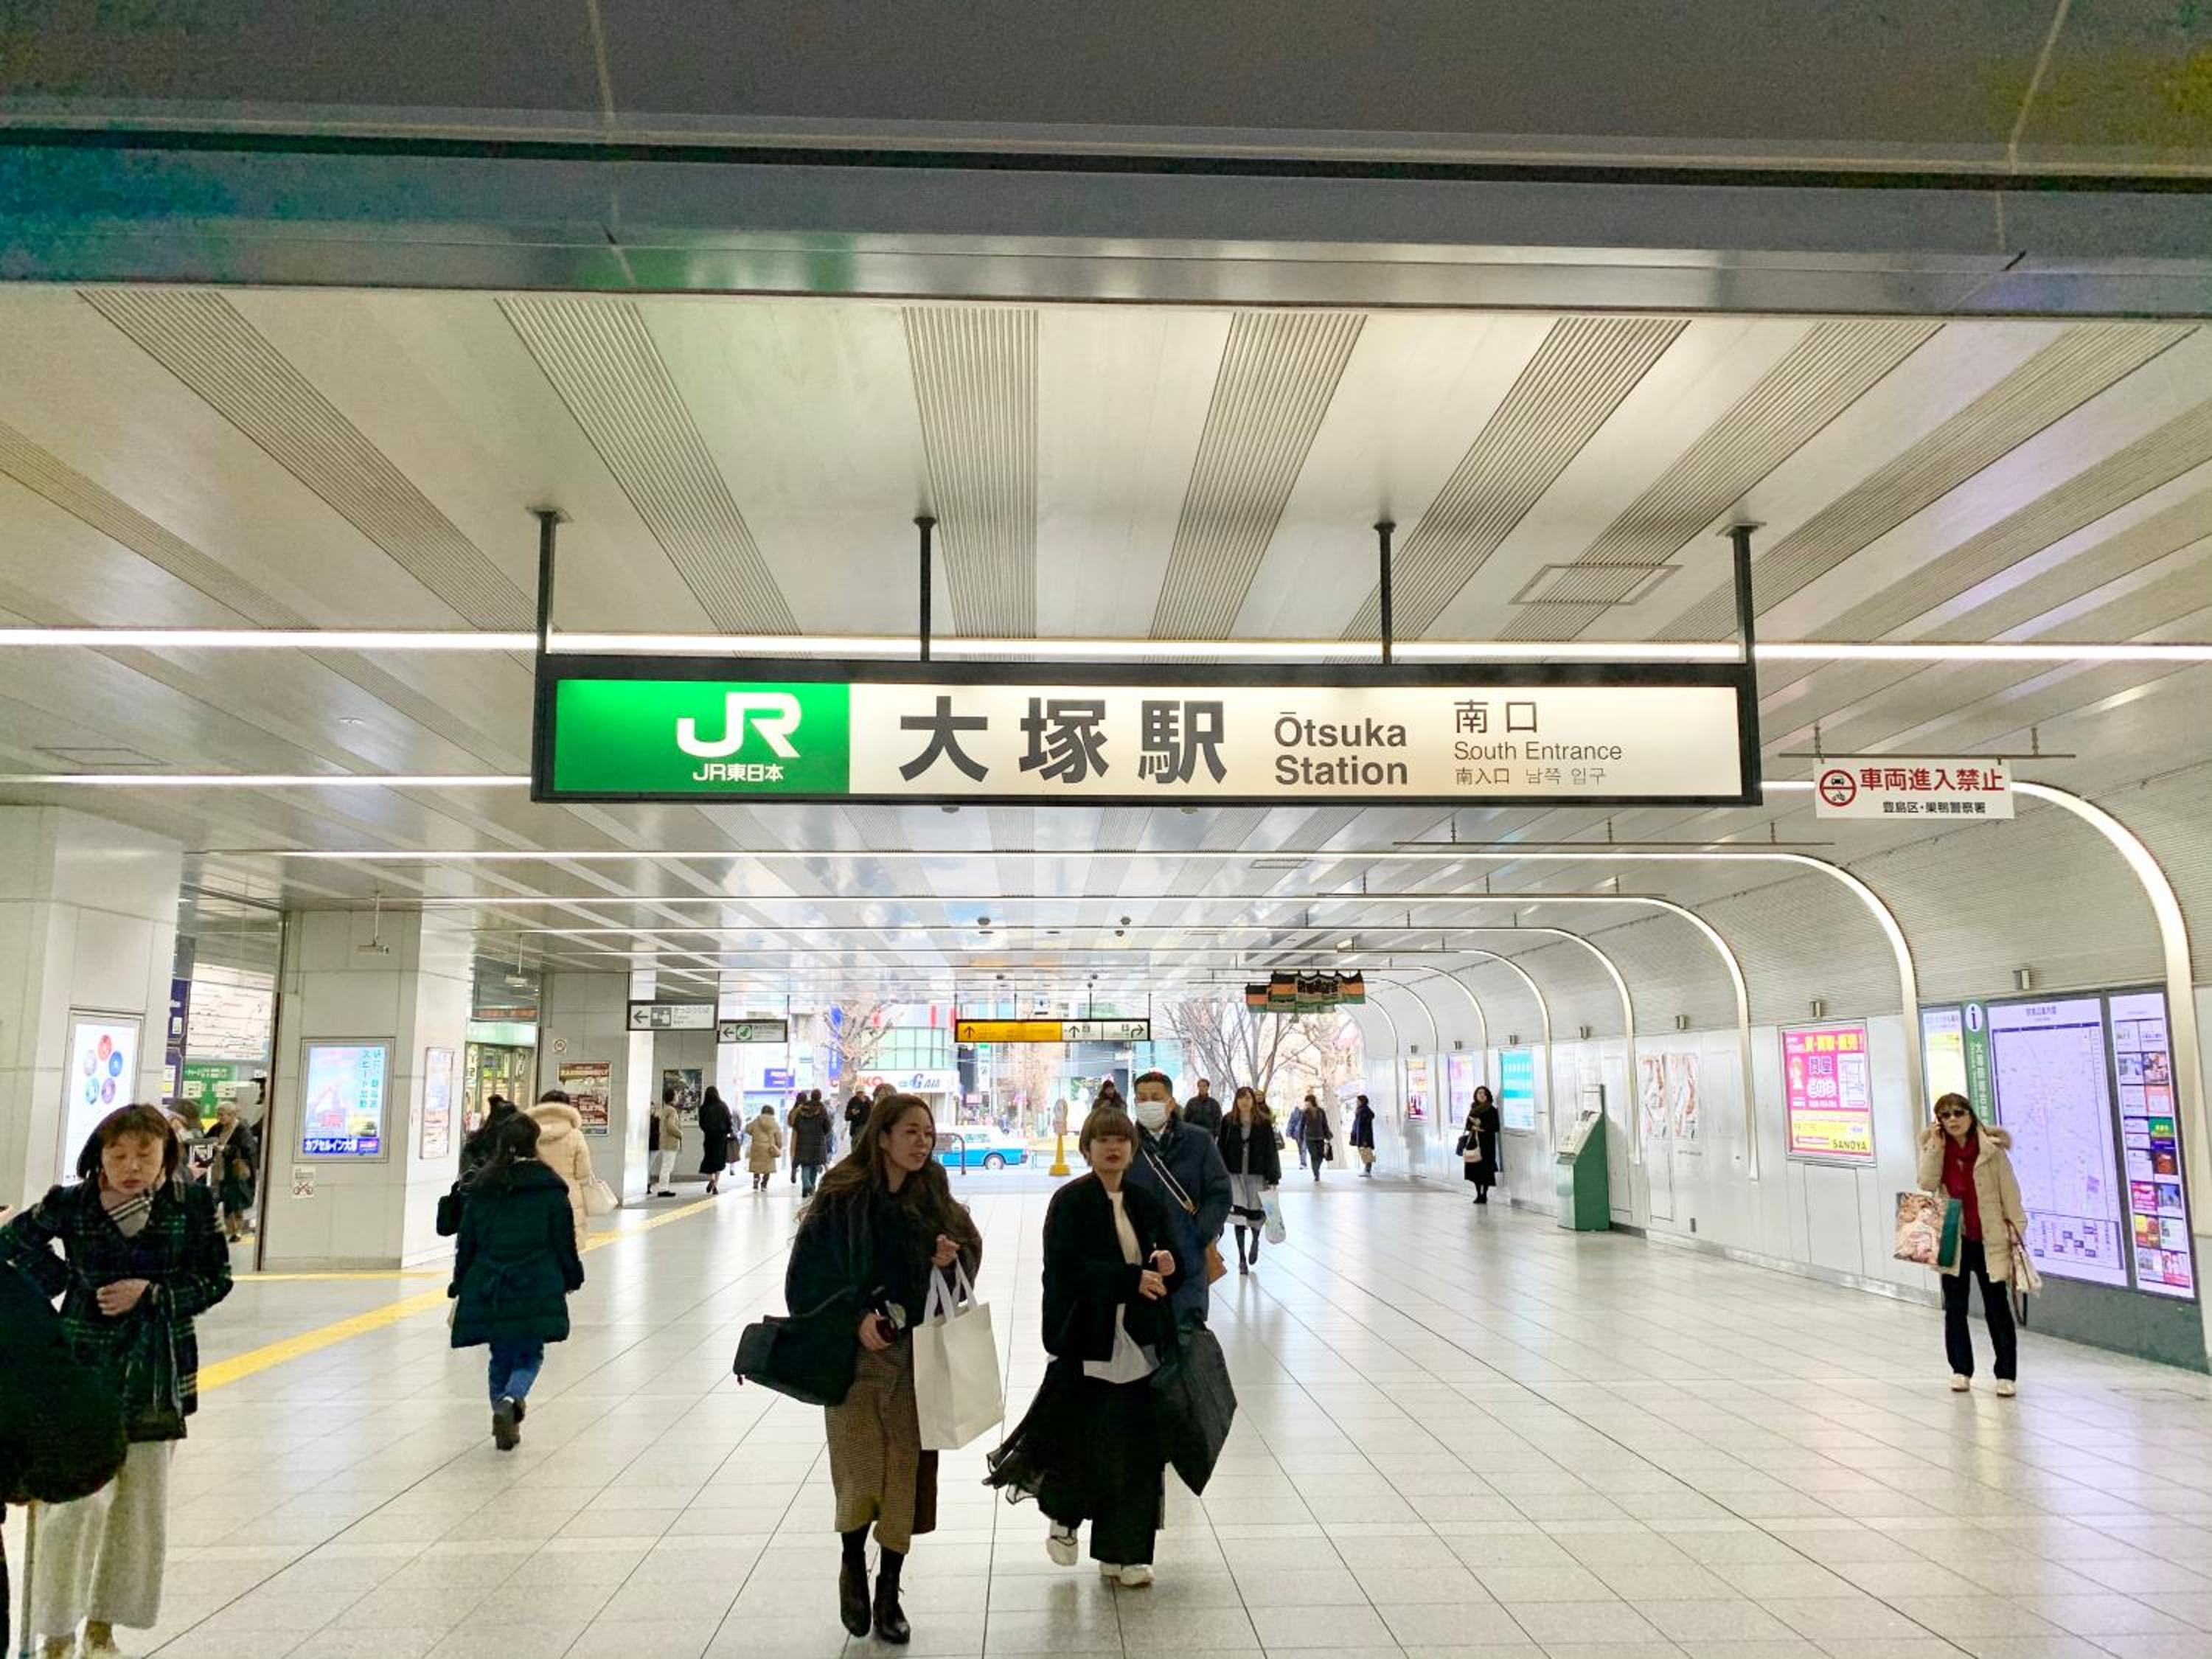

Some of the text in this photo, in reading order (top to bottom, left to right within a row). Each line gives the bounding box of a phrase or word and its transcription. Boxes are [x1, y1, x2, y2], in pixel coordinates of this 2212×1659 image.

[675, 691, 802, 759] JR
[1453, 699, 1538, 734] 南口
[898, 695, 1227, 785] 大塚駅
[1274, 712, 1408, 748] Ōtsuka
[1453, 741, 1622, 761] South Entrance
[692, 762, 785, 783] JR東日本
[1274, 756, 1408, 786] Station
[1455, 768, 1511, 785] 南入口
[1525, 768, 1608, 785] 남쪽 입구
[1859, 768, 2006, 791] 車両進入禁止
[1832, 1138, 1868, 1150] SANOYA
